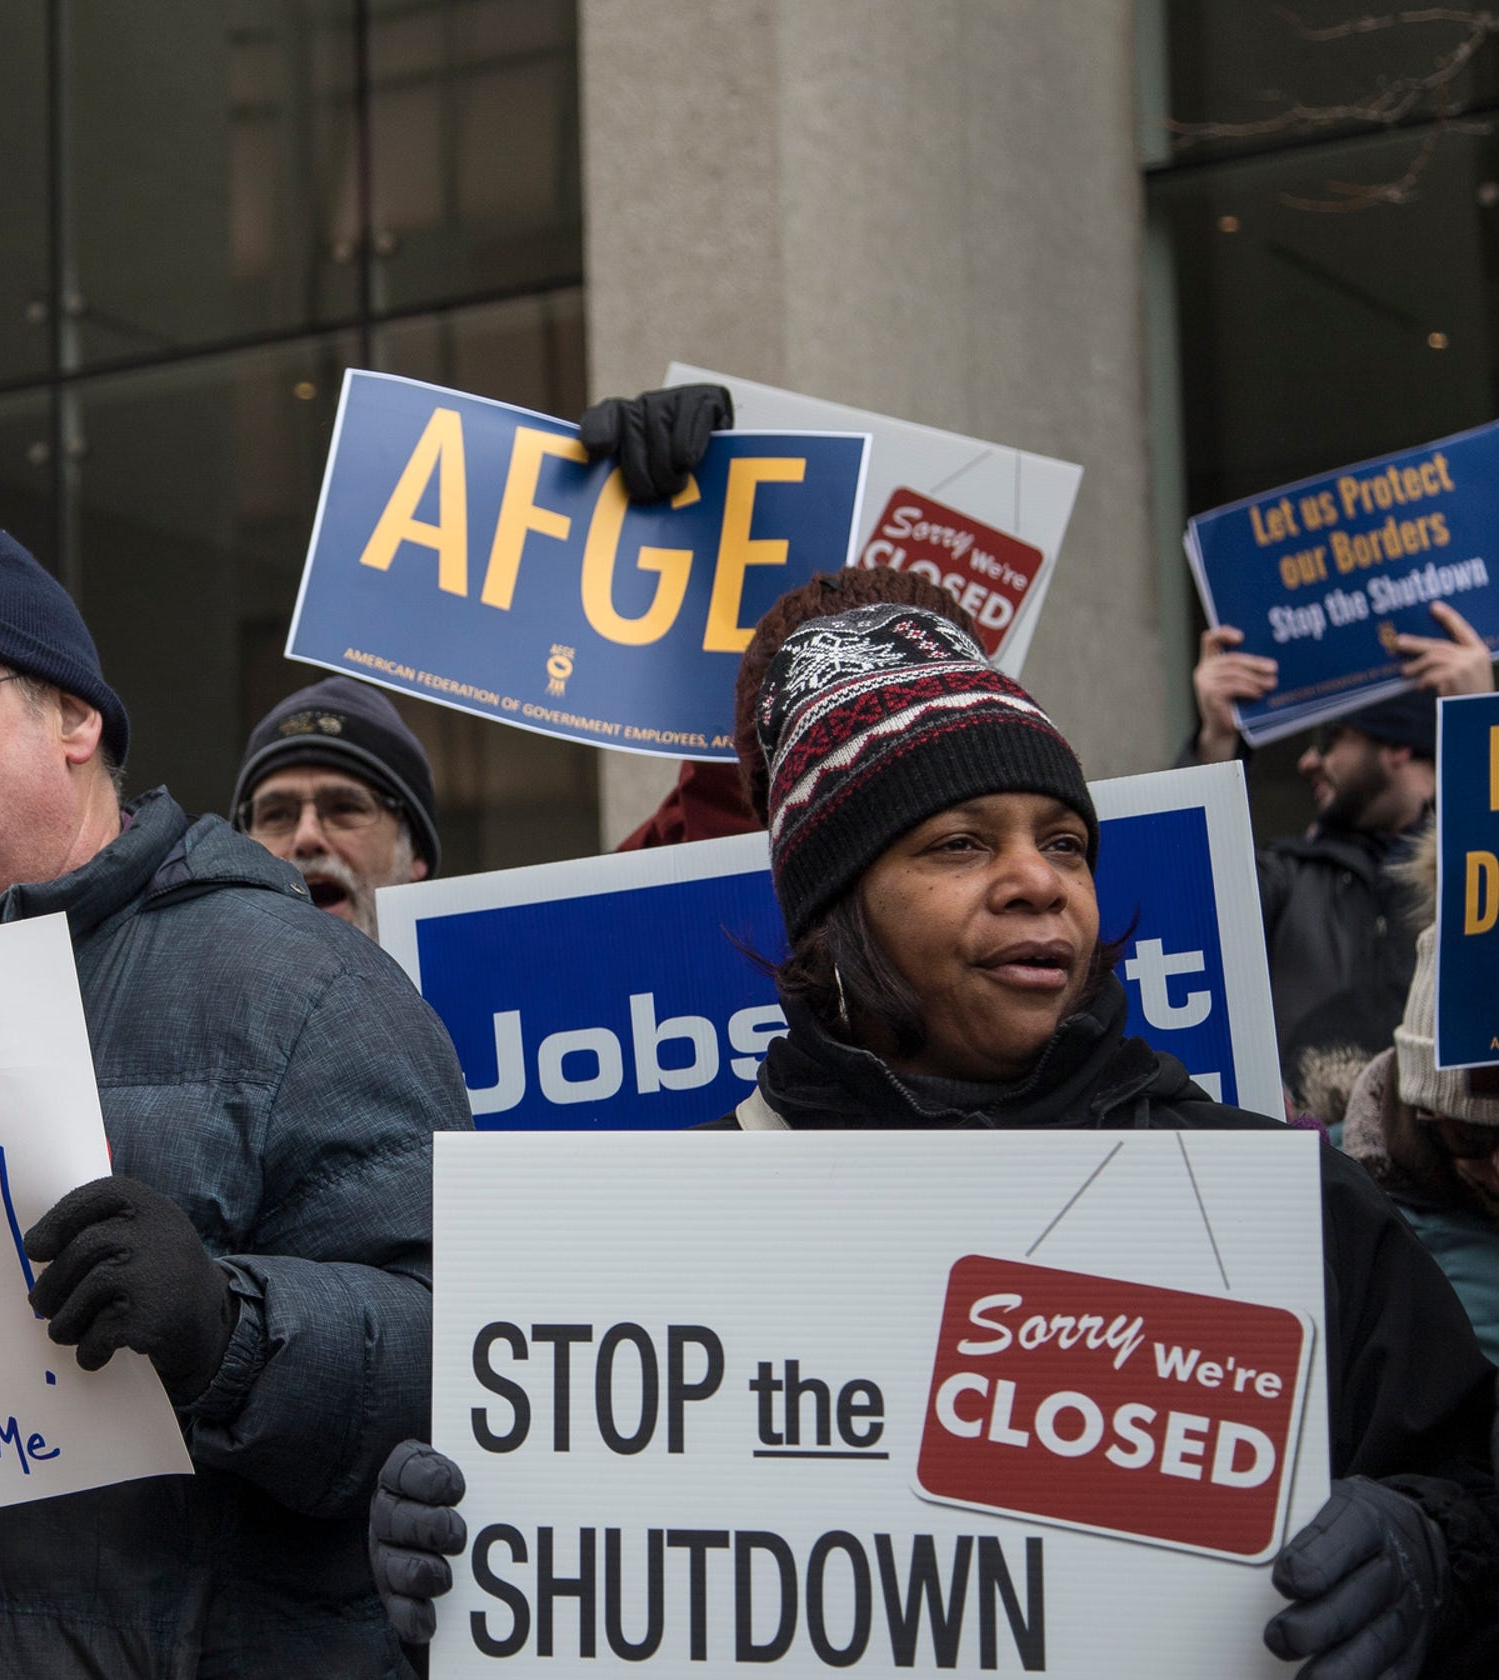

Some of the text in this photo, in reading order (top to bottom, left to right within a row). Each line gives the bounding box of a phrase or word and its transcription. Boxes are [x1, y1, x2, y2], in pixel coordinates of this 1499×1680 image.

[359, 406, 806, 653] AFGE
[882, 506, 1028, 591] Sorry We're
[1249, 452, 1455, 547] Let us Protect
[1279, 512, 1450, 590] our Borders
[1268, 556, 1489, 643] Stop the Shutdown
[343, 647, 416, 681] AMERICAN
[417, 671, 499, 706] FEDERATION
[500, 696, 521, 712] OF
[521, 703, 622, 737] GOVERNMENT
[624, 725, 709, 748] EMPLOYEES,
[464, 991, 791, 1116] Jobs
[469, 1320, 888, 1459] STOP the
[956, 1292, 1285, 1400] Sorry We're
[933, 1371, 1277, 1491] CLOSED
[468, 1522, 1048, 1674] SHUTDOWN
